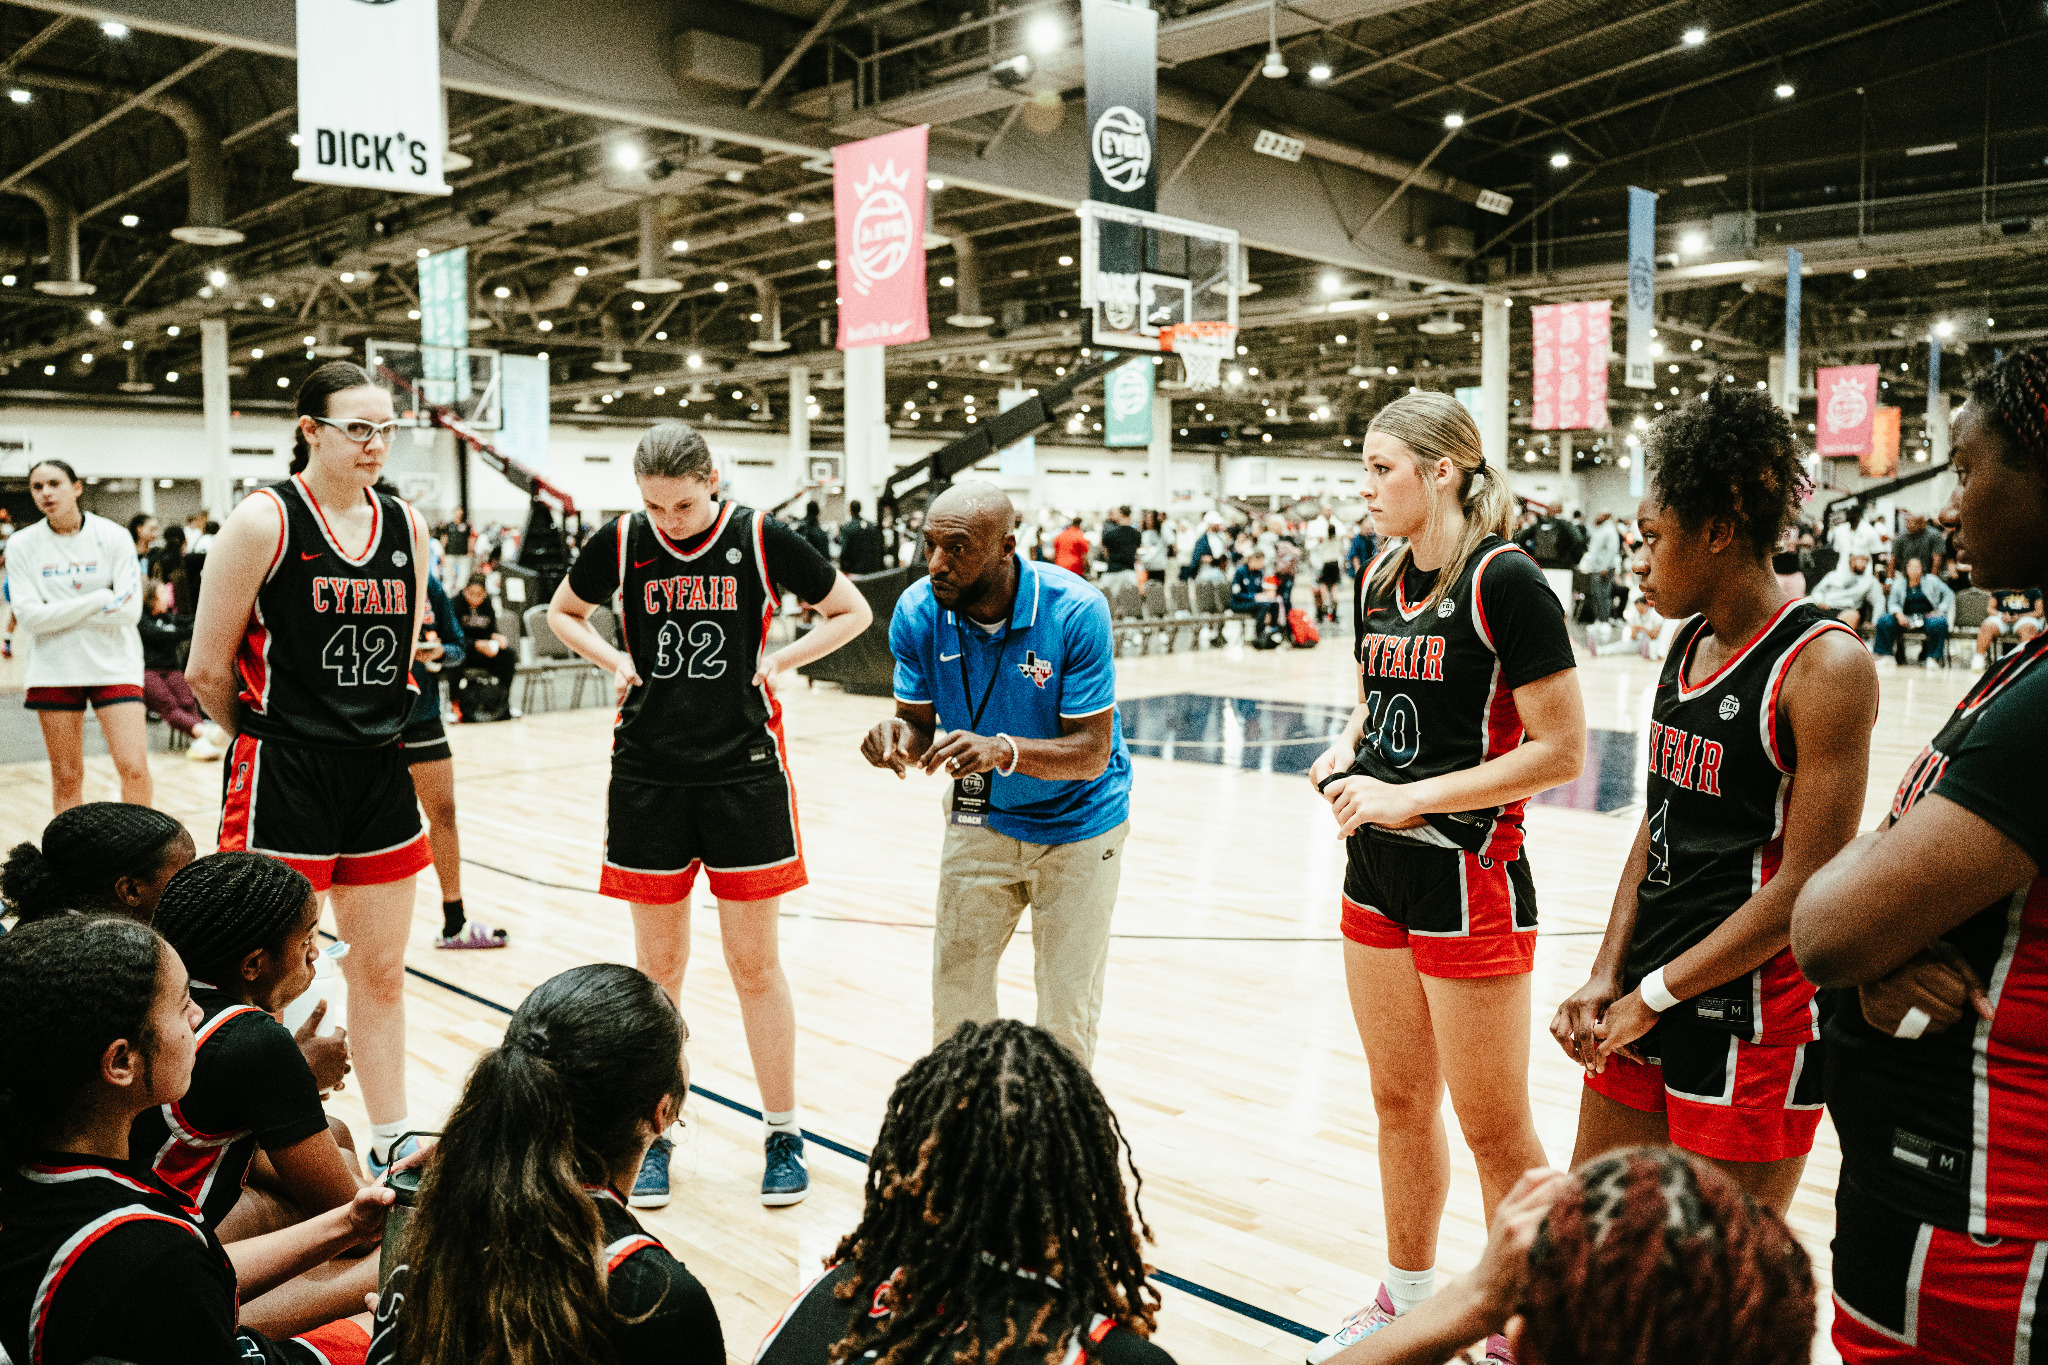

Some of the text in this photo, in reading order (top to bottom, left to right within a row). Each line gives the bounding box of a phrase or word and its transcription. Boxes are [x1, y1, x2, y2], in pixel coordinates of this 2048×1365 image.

[317, 128, 427, 175] DICK'S
[312, 576, 408, 615] CYFAIR
[644, 575, 738, 615] CYFAIR
[322, 625, 398, 686] 42
[1721, 701, 1737, 711] EYBL
[1649, 719, 1723, 797] YFAIR
[1731, 1005, 1742, 1016] M
[1940, 1154, 1955, 1171] M
